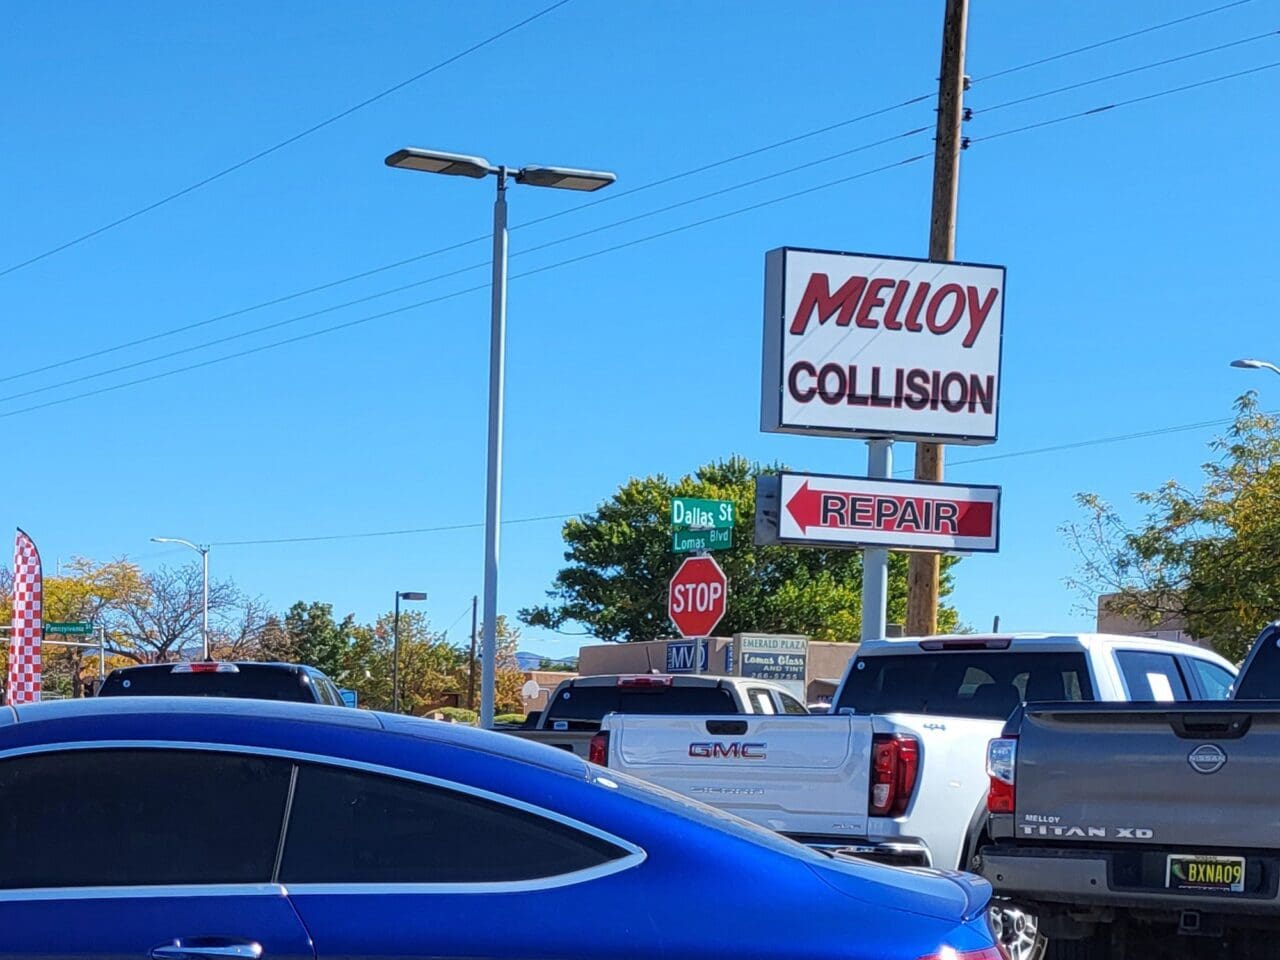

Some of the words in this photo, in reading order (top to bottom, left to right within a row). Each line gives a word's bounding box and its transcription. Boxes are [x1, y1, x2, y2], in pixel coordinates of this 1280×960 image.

[789, 272, 999, 348] MELLOY
[788, 361, 995, 415] COLLISION
[673, 500, 715, 526] Dallas
[719, 503, 732, 521] St
[820, 494, 960, 534] REPAIR
[674, 533, 705, 550] Lomas
[710, 529, 729, 542] Blvd
[673, 582, 721, 613] STOP
[743, 639, 778, 648] EMERALD
[781, 640, 805, 649] PLAZA
[744, 653, 774, 664] Lomas
[778, 655, 803, 666] Glass
[688, 742, 767, 759] GMC
[1025, 814, 1061, 823] MELLOY
[1019, 824, 1106, 837] TITAN
[1115, 828, 1153, 839] XD
[1188, 863, 1241, 884] BXNA09
